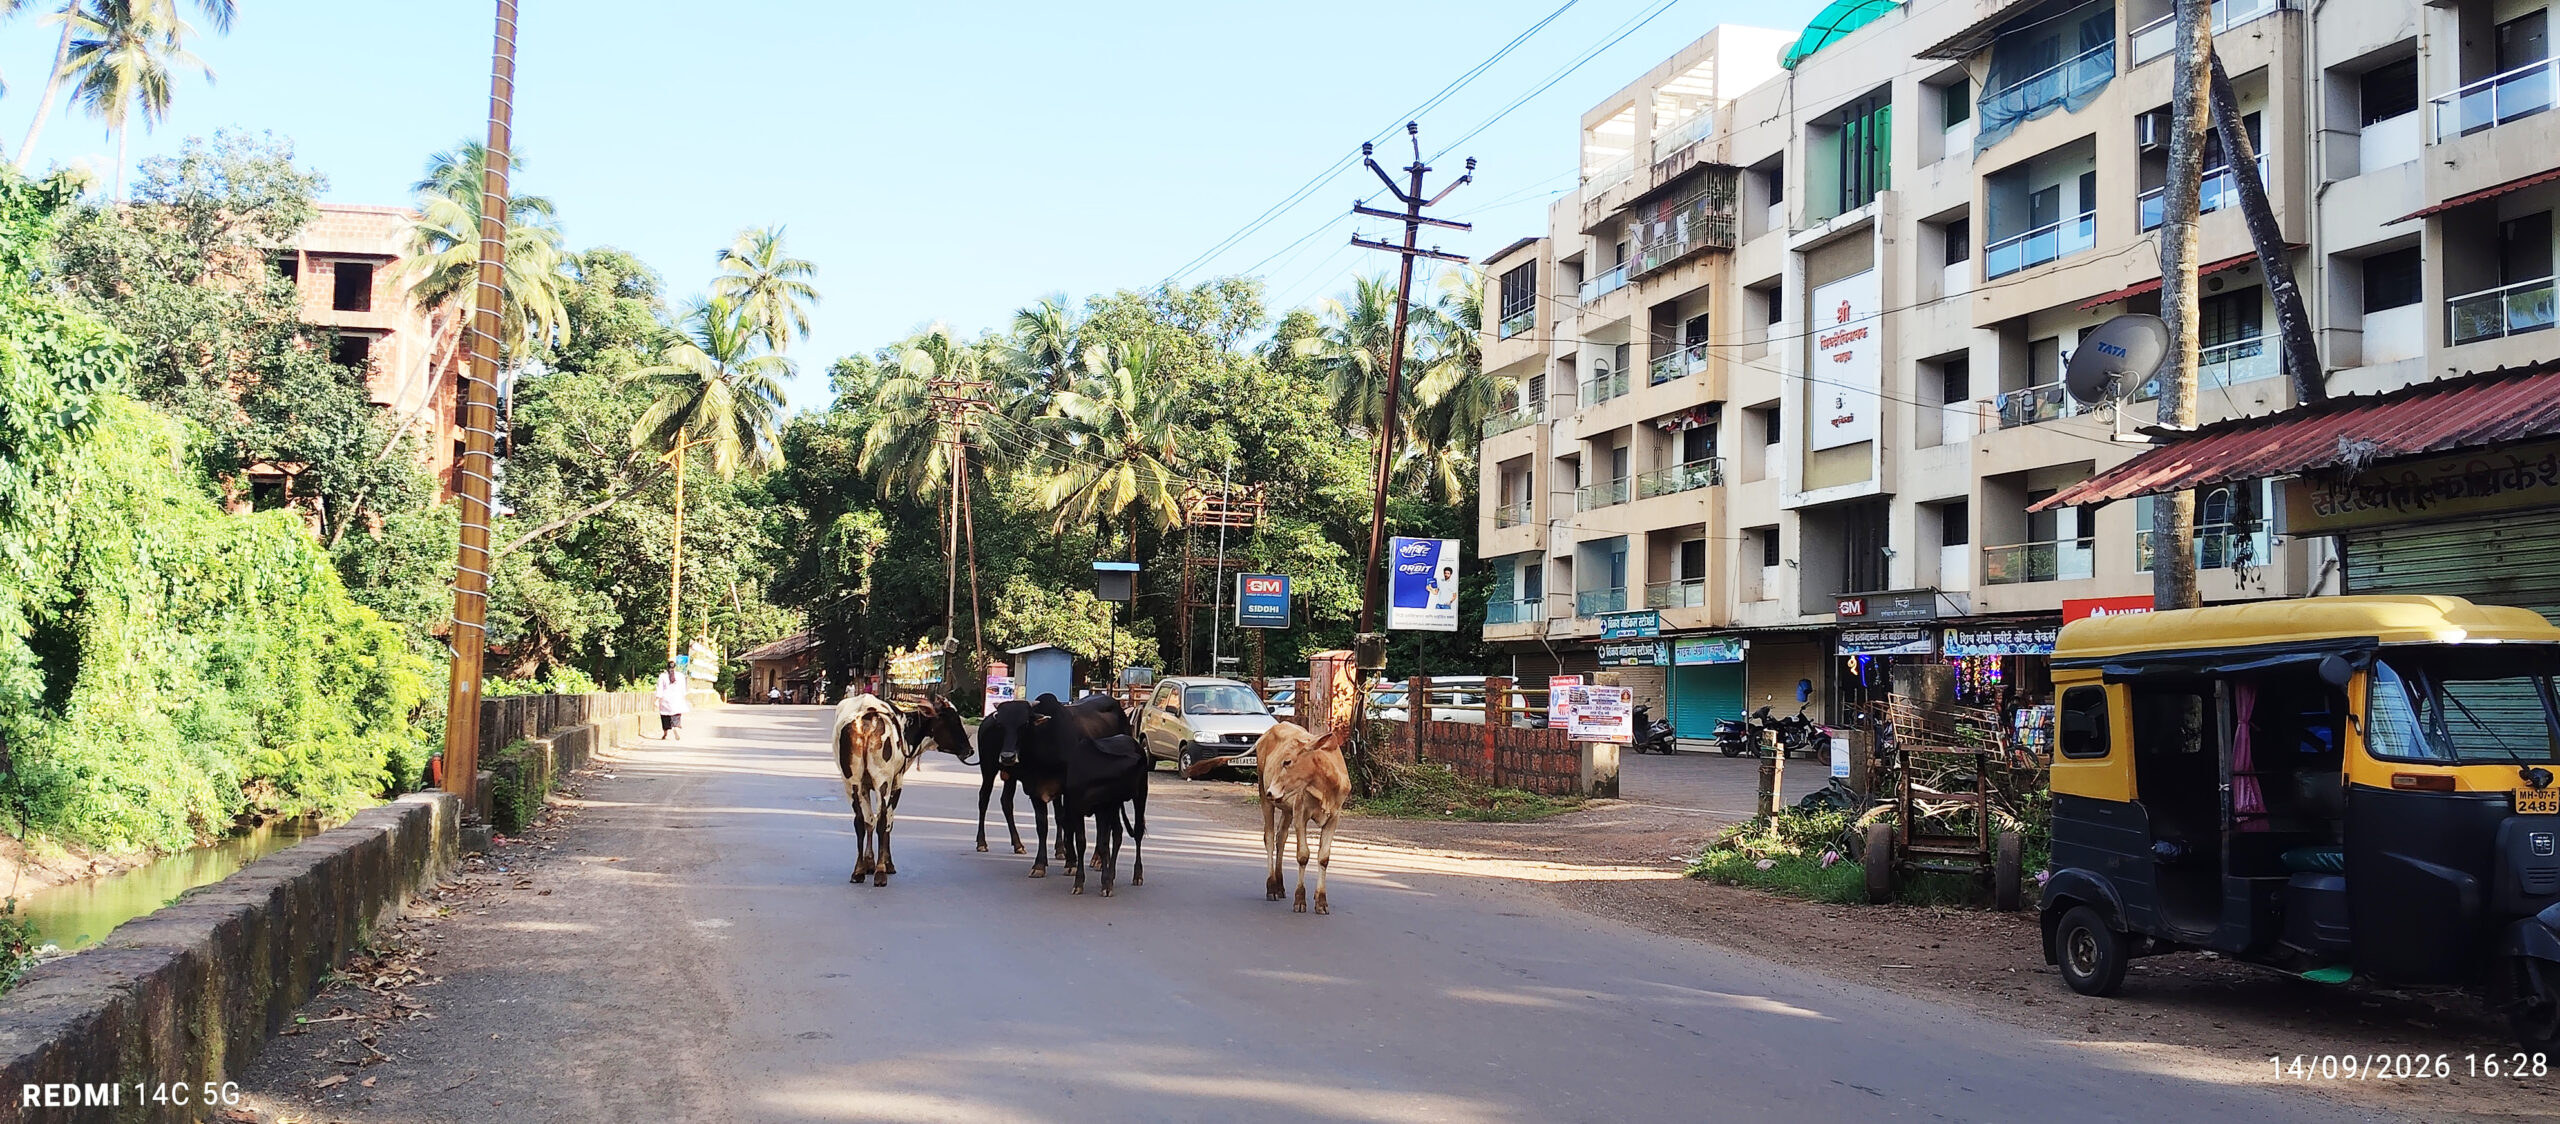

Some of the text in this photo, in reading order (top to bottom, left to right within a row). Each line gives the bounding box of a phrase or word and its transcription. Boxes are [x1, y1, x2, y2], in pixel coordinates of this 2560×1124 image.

[1837, 300, 1851, 324] श्री
[2098, 341, 2126, 358] TATA
[1399, 563, 1433, 574] ORBIT
[1248, 581, 1280, 592] GM
[1248, 604, 1279, 613] SIDDHI
[1839, 600, 1861, 614] GM
[1621, 615, 1638, 628] मेडिकल
[1959, 632, 1974, 645] शिव
[1619, 643, 1637, 656] मेडिकल
[2518, 801, 2558, 812] 2485
